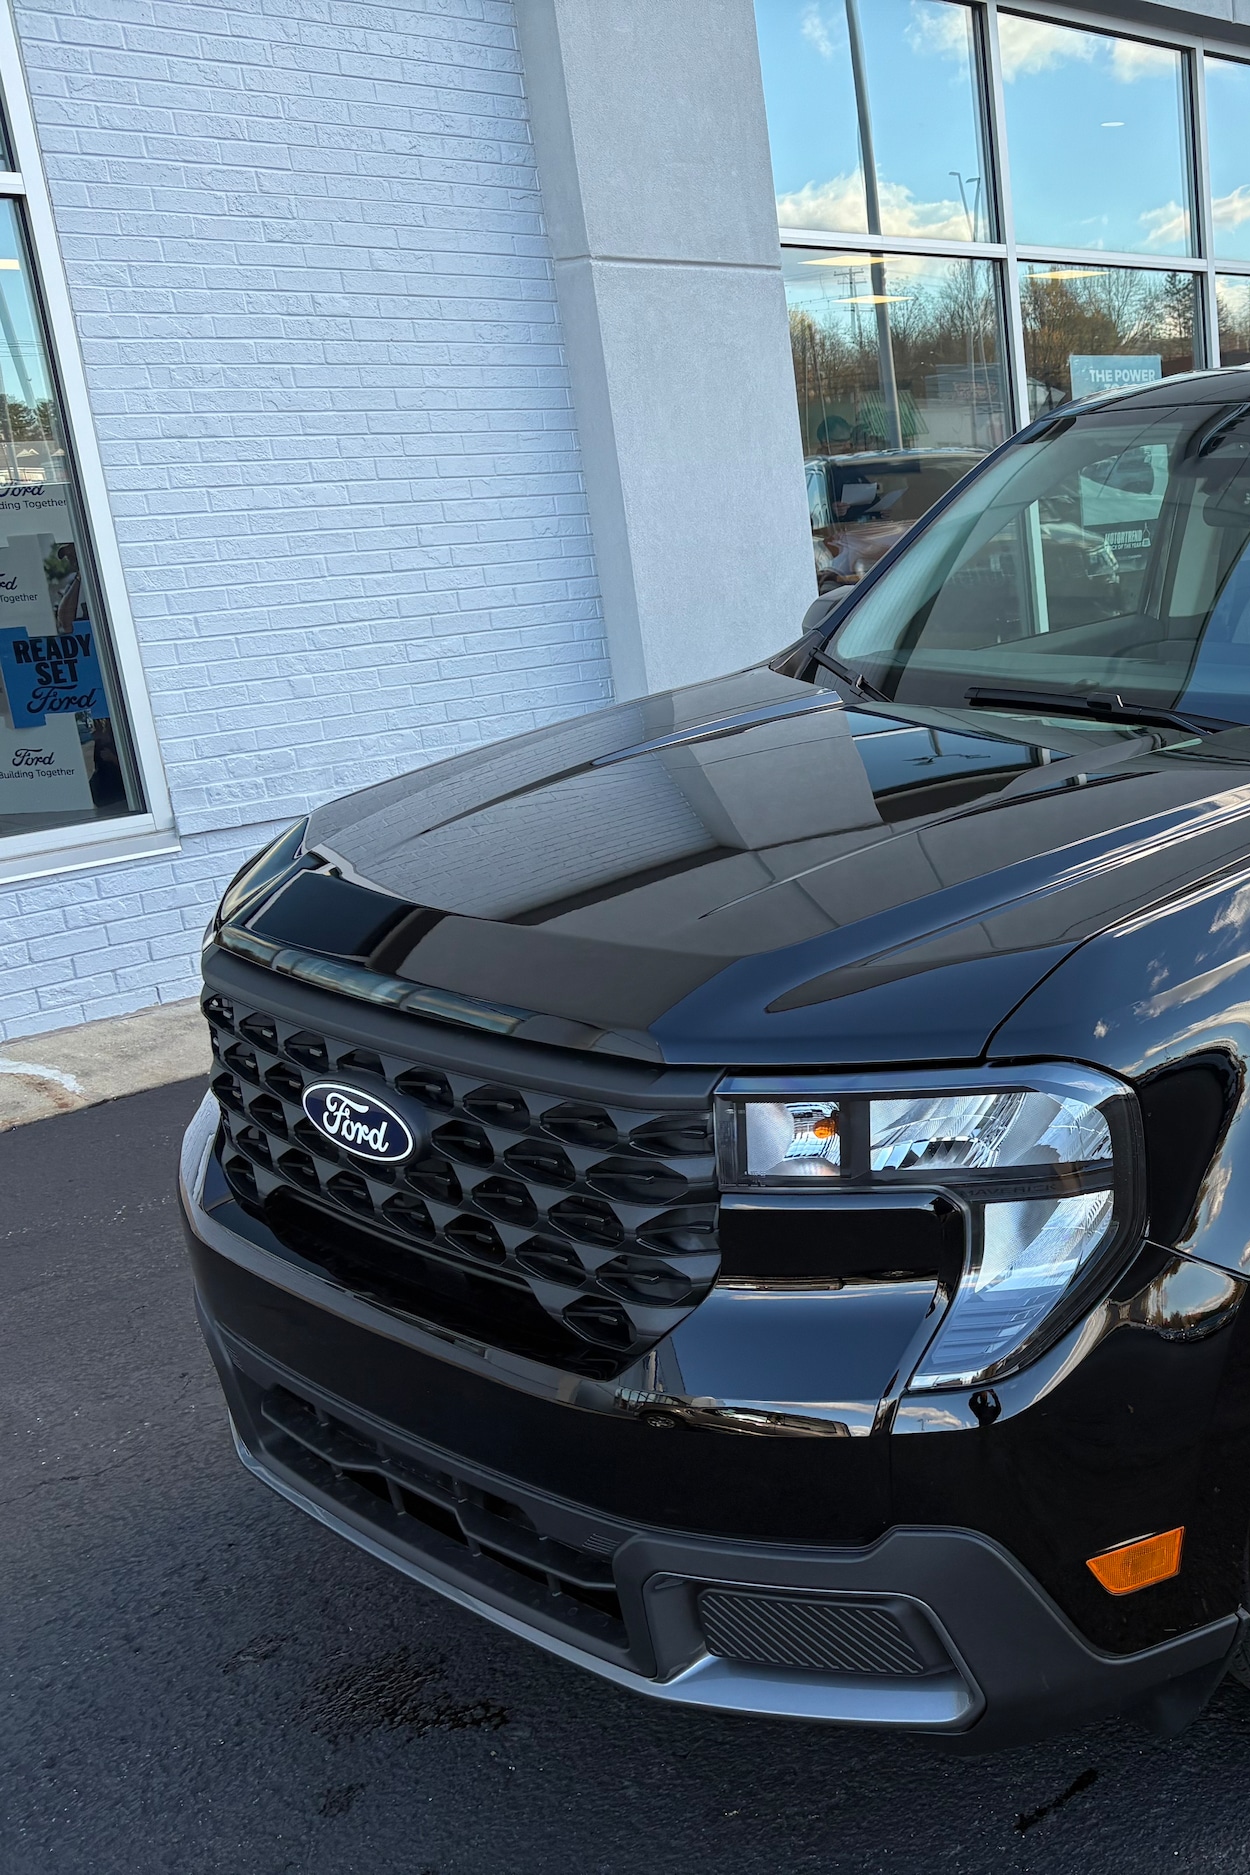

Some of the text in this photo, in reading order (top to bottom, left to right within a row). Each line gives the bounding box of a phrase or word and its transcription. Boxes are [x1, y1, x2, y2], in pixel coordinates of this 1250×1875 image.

[1089, 369, 1156, 382] THE POWER
[13, 633, 91, 664] READY
[35, 659, 78, 685] SET
[27, 684, 97, 714] Ford
[12, 748, 55, 767] Ford
[36, 767, 75, 779] Together
[323, 1092, 389, 1152] Ford
[961, 1183, 1058, 1198] MAVERICK
